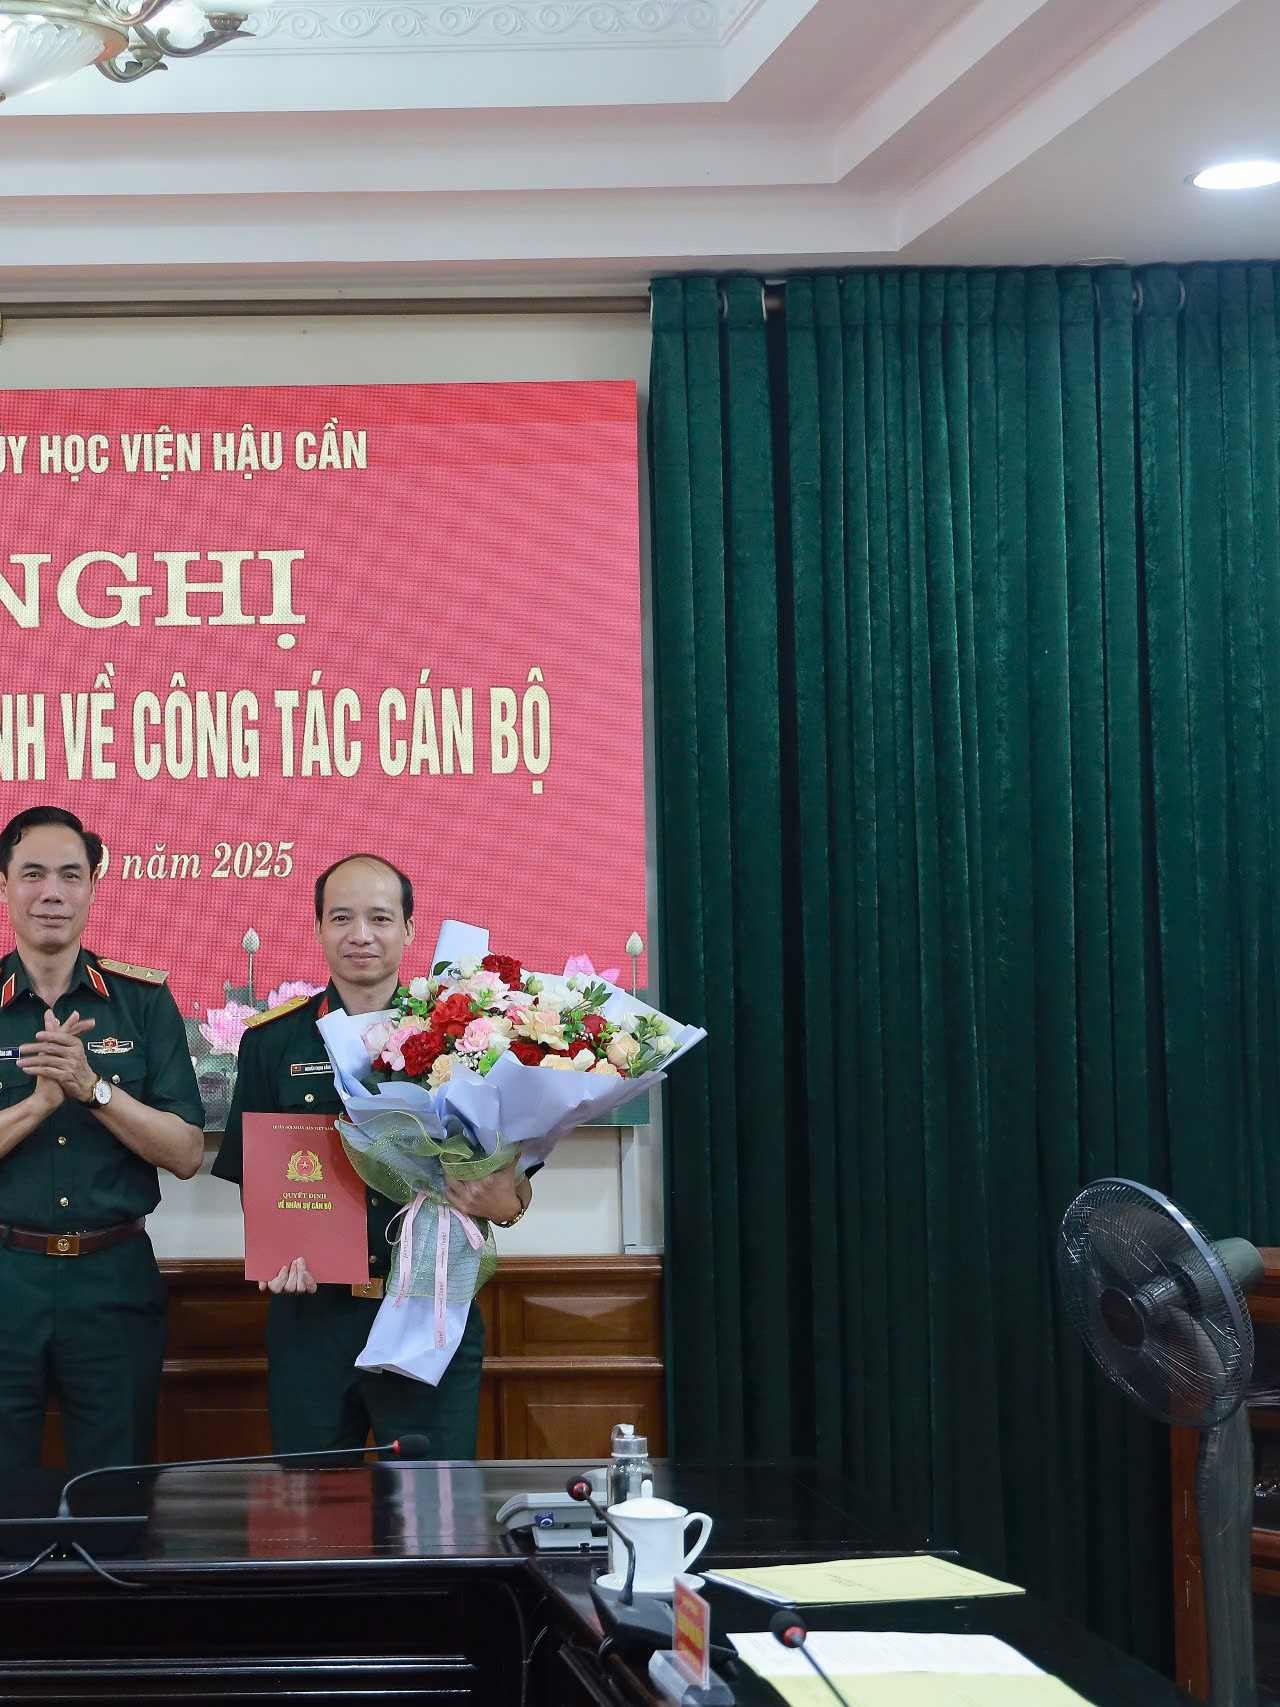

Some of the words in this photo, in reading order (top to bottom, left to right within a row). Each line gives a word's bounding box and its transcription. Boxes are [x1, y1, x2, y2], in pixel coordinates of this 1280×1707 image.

[40, 434, 109, 482] HỌC
[120, 425, 201, 481] VIỆN
[213, 423, 283, 480] HẬU
[295, 417, 368, 470] CẦN
[60, 662, 116, 781] VỀ
[133, 672, 260, 780] CÔNG
[274, 670, 362, 778] TÁC
[377, 668, 474, 777] CÁN
[490, 667, 552, 794] BỘ
[122, 843, 201, 880] năm
[211, 841, 295, 879] 2025
